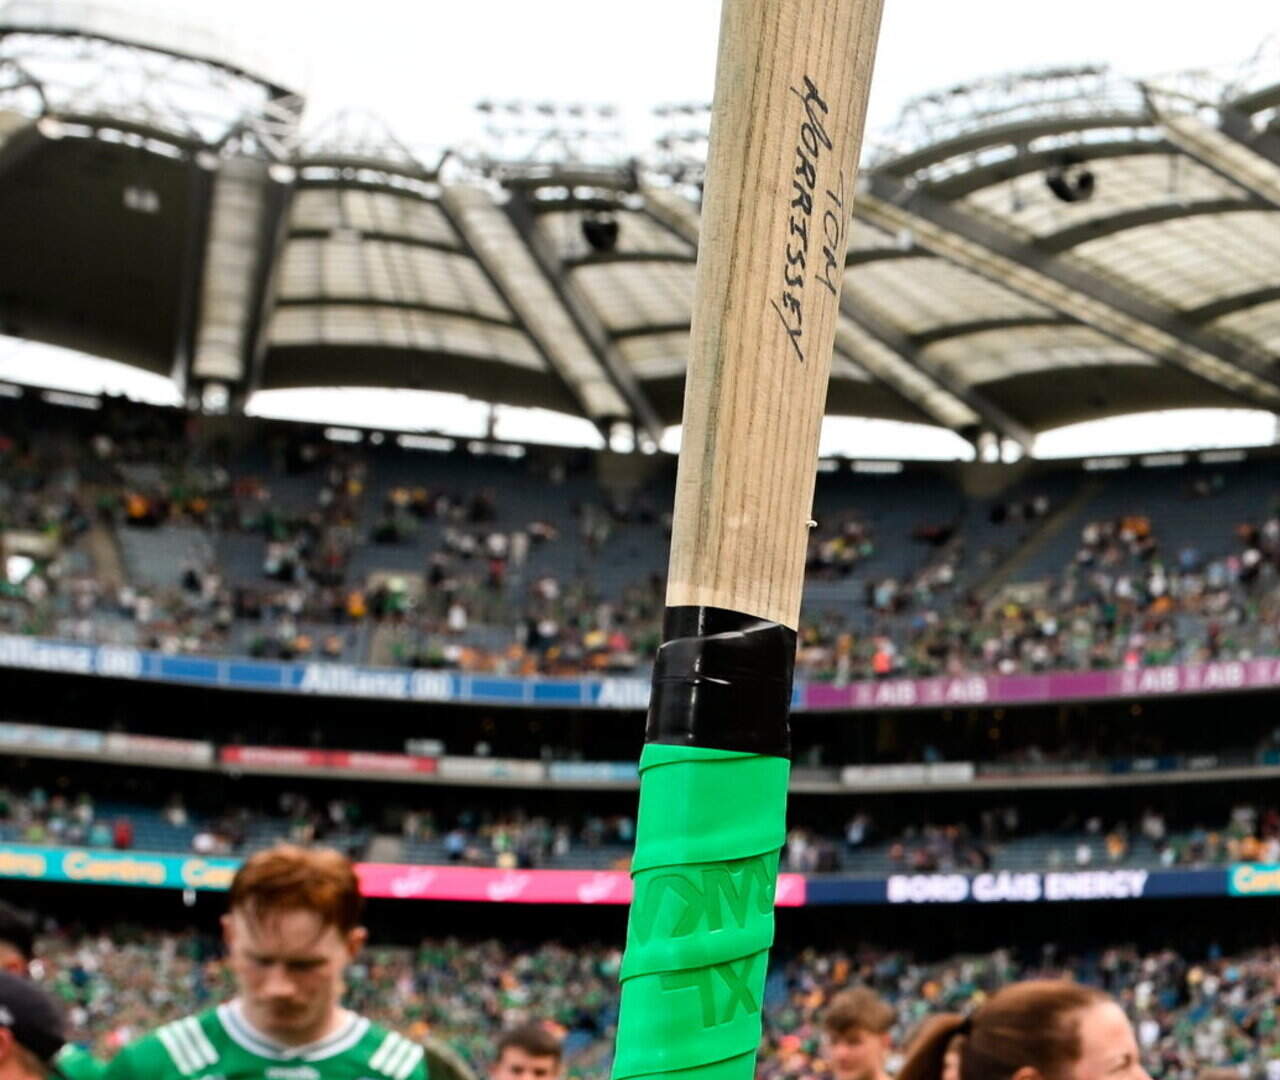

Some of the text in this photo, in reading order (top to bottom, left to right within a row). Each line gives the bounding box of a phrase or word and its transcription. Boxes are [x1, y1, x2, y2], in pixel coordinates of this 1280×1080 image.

[815, 170, 844, 296] TOM
[62, 851, 166, 885] Centra
[887, 875, 969, 902] BORD
[1044, 870, 1148, 900] ENERGY
